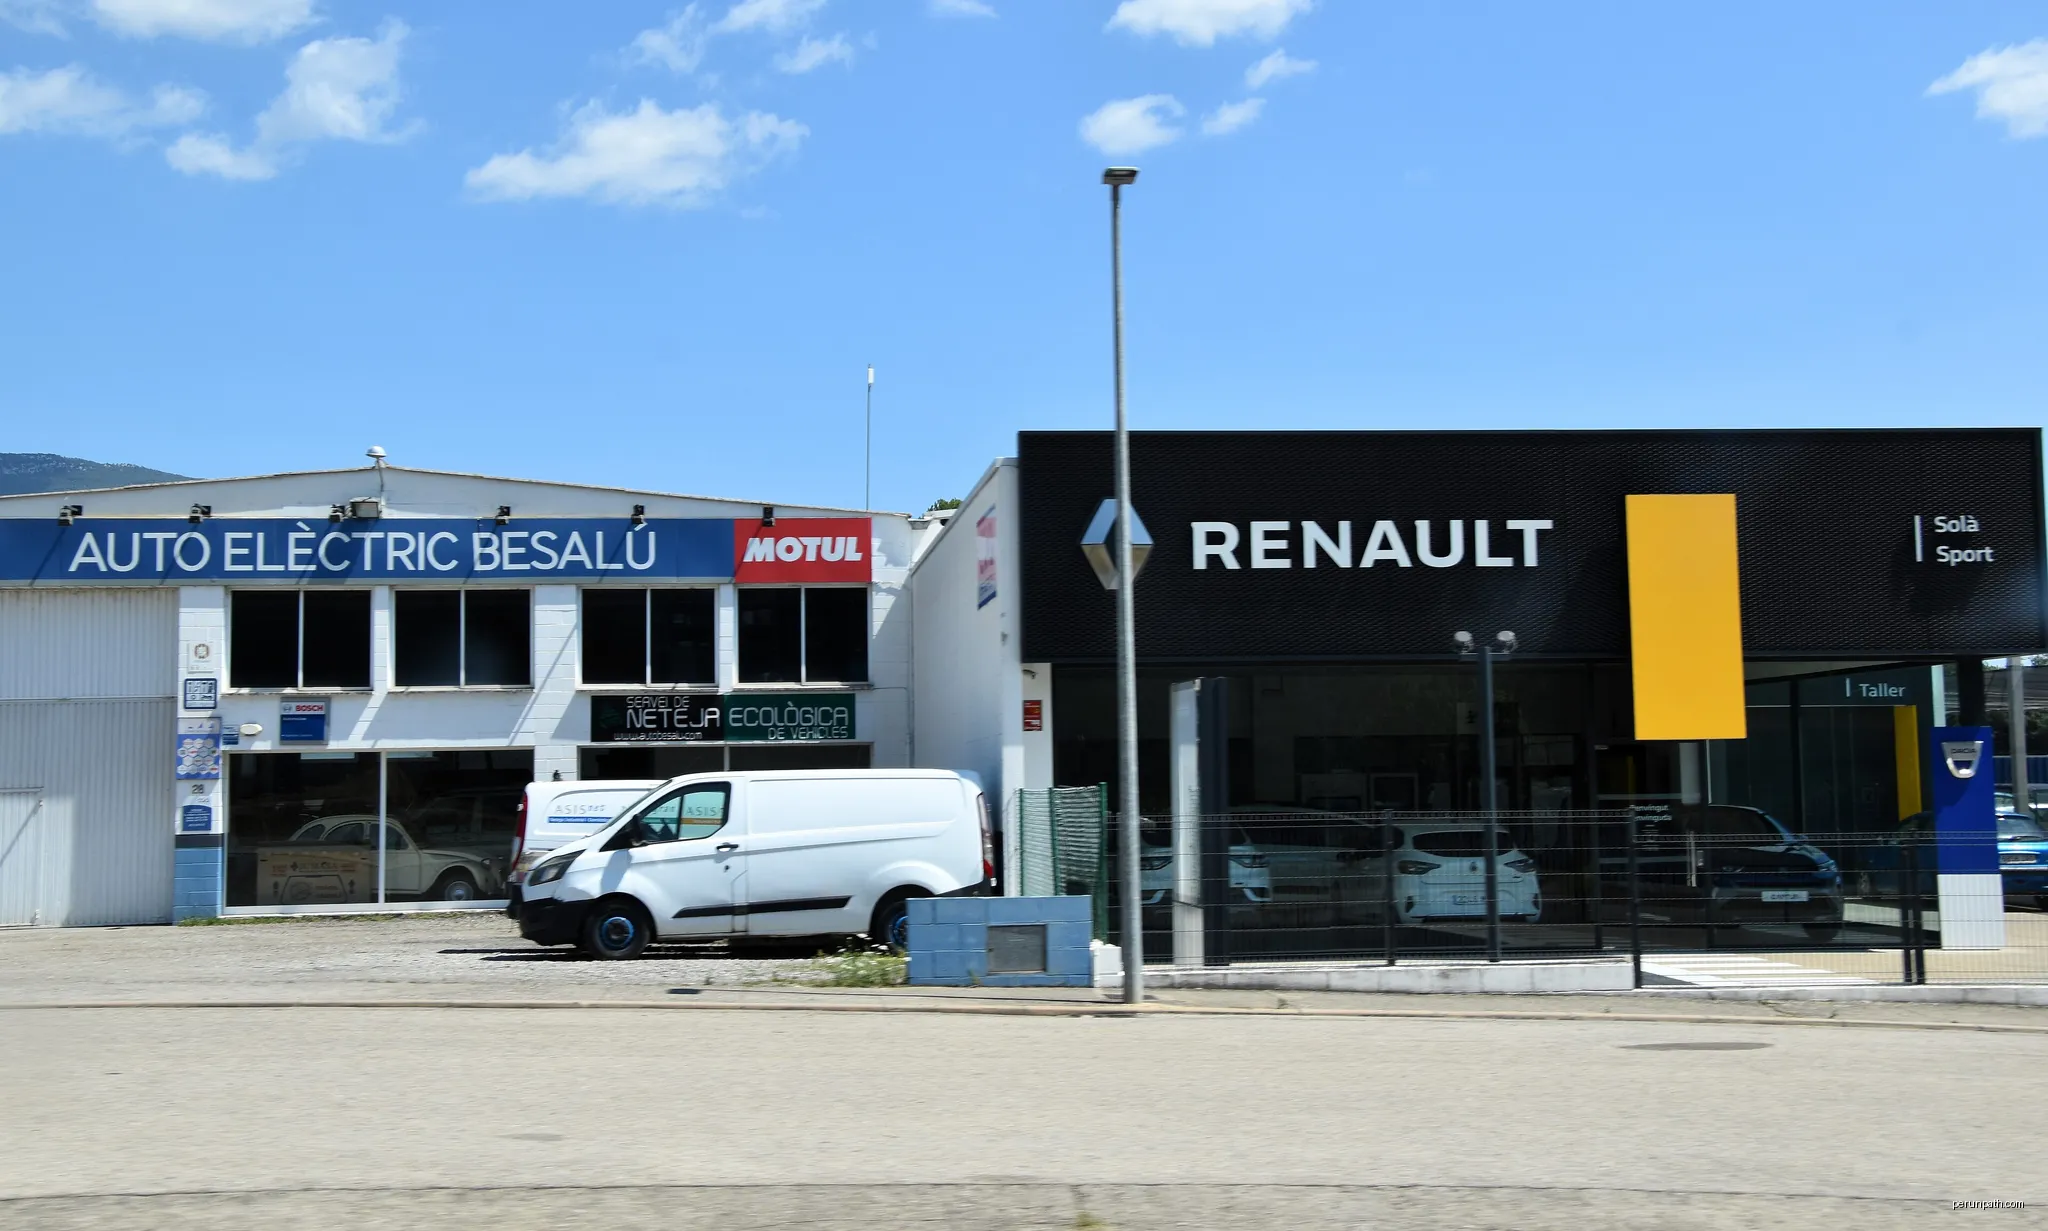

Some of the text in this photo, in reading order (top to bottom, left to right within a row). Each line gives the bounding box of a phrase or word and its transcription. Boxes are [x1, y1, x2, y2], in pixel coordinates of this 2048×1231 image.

[1934, 515, 1980, 533] Solà
[69, 521, 656, 573] AUTO ELÈCTRIC BESALÚ
[743, 536, 863, 563] MOTUL
[1191, 519, 1554, 571] RENAULT
[1936, 545, 1995, 567] Sport
[1858, 683, 1906, 697] Taller
[673, 696, 690, 708] DE
[626, 701, 848, 728] NETEJA ECOLÒGICA
[768, 726, 848, 740] DE VEHICLES
